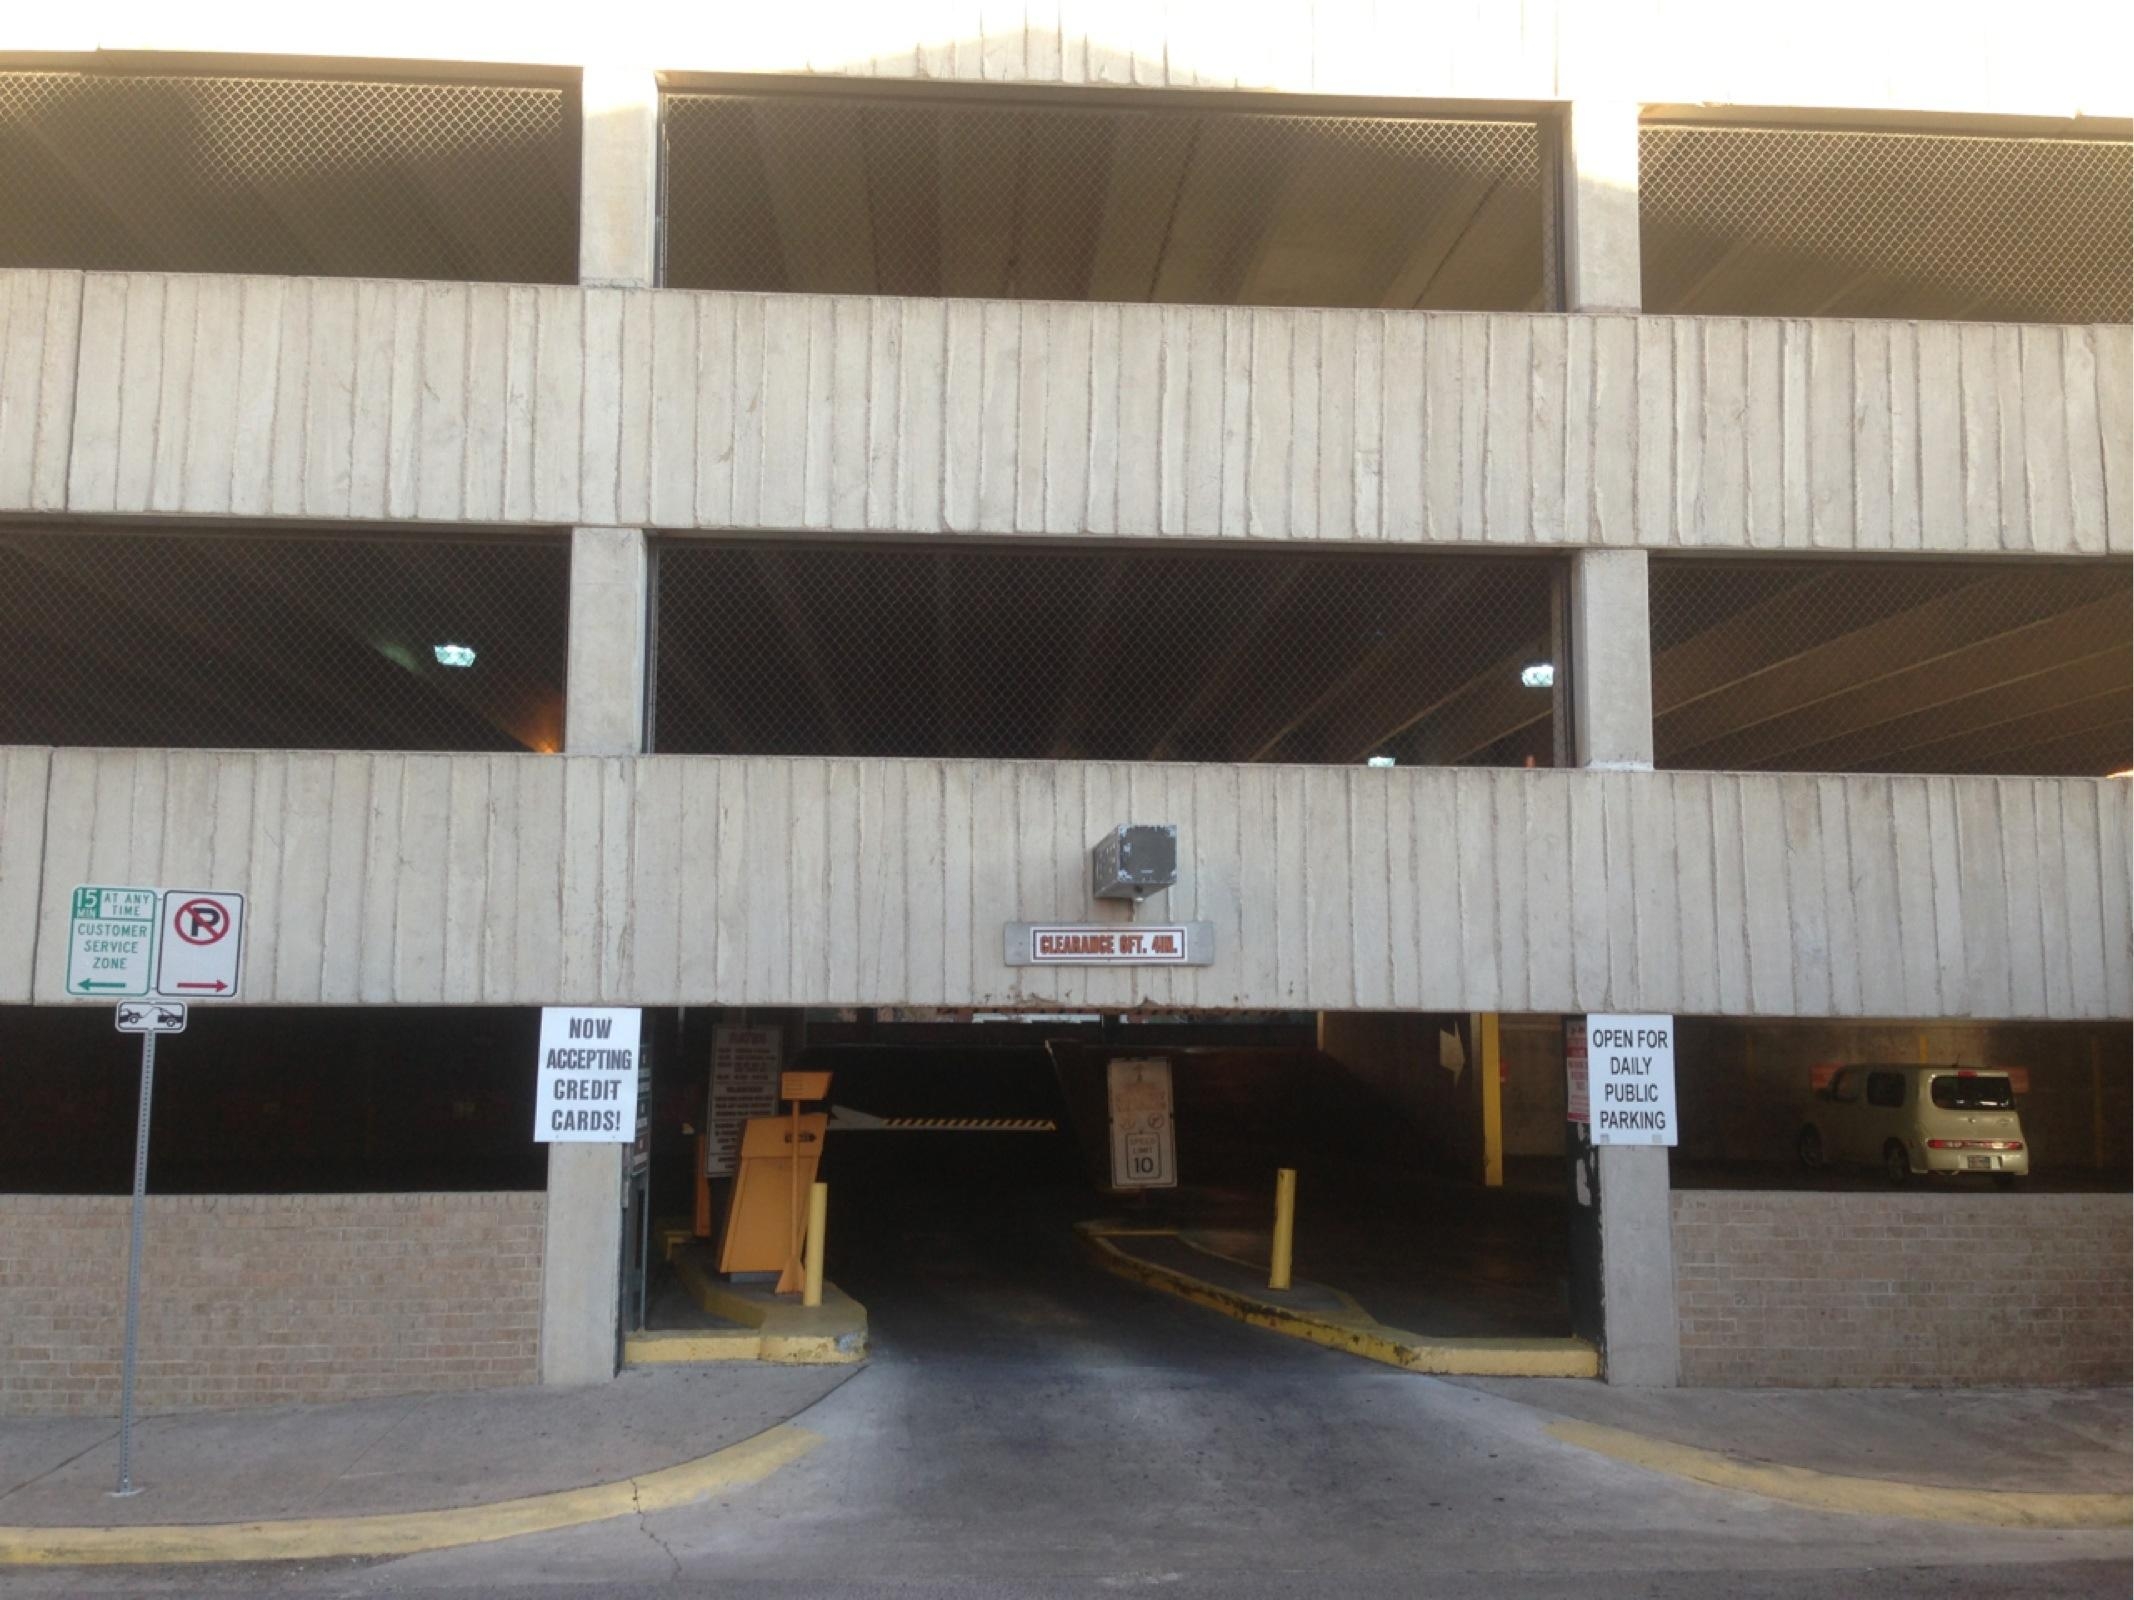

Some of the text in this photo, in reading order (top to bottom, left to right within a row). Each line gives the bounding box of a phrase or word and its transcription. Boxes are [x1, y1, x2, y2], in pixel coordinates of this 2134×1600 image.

[77, 889, 98, 908] 15
[104, 893, 150, 904] AT ANY
[112, 905, 141, 916] TIME
[78, 923, 147, 937] CUSTOMER
[83, 940, 139, 954] SERVICE
[1039, 934, 1114, 954] CLEARANCE
[92, 957, 127, 970] ZONE
[569, 1017, 613, 1039] NOW
[1592, 1029, 1634, 1048] OPEN
[1638, 1029, 1668, 1049] FOR
[546, 1048, 633, 1071] ACCEPTING
[1610, 1056, 1653, 1076] DAILY
[553, 1078, 622, 1101] CREDIT
[1604, 1083, 1659, 1103] PUBLIC
[551, 1109, 621, 1132] CARDS!
[1600, 1110, 1666, 1130] PARKING
[1134, 1156, 1154, 1173] 10
